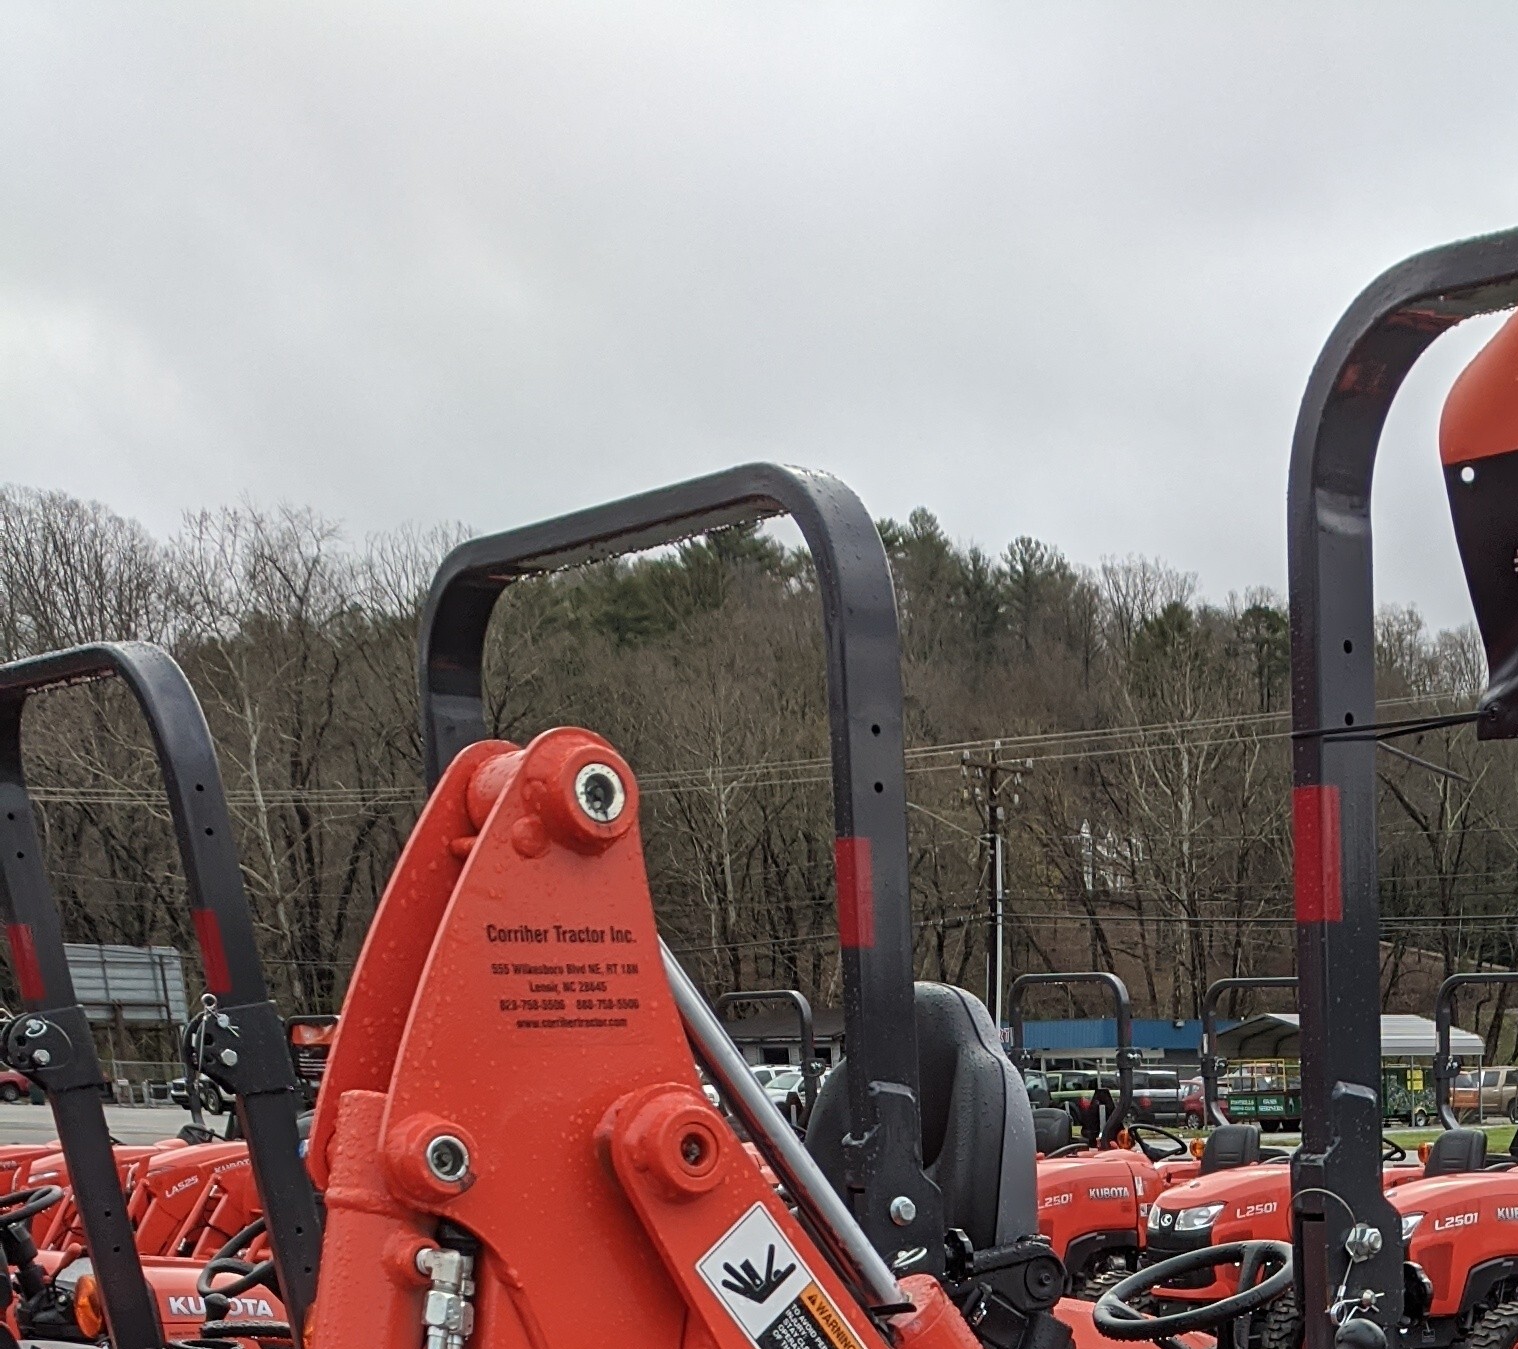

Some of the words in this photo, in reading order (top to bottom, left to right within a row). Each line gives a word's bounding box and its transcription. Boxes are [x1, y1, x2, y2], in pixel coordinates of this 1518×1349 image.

[486, 924, 549, 944] Corriher
[553, 925, 606, 944] Tractor
[609, 925, 638, 944] Inc.
[214, 1159, 250, 1174] KUBOT
[1089, 1187, 1130, 1200] KUBOTA
[1236, 1201, 1278, 1219] L2501
[1434, 1212, 1478, 1231] L2501
[169, 1296, 274, 1318] KUOTA
[782, 1319, 798, 1339] STAY
[790, 1303, 801, 1316] TO
[799, 1311, 818, 1338] AVOID
[772, 1329, 783, 1341] OF
